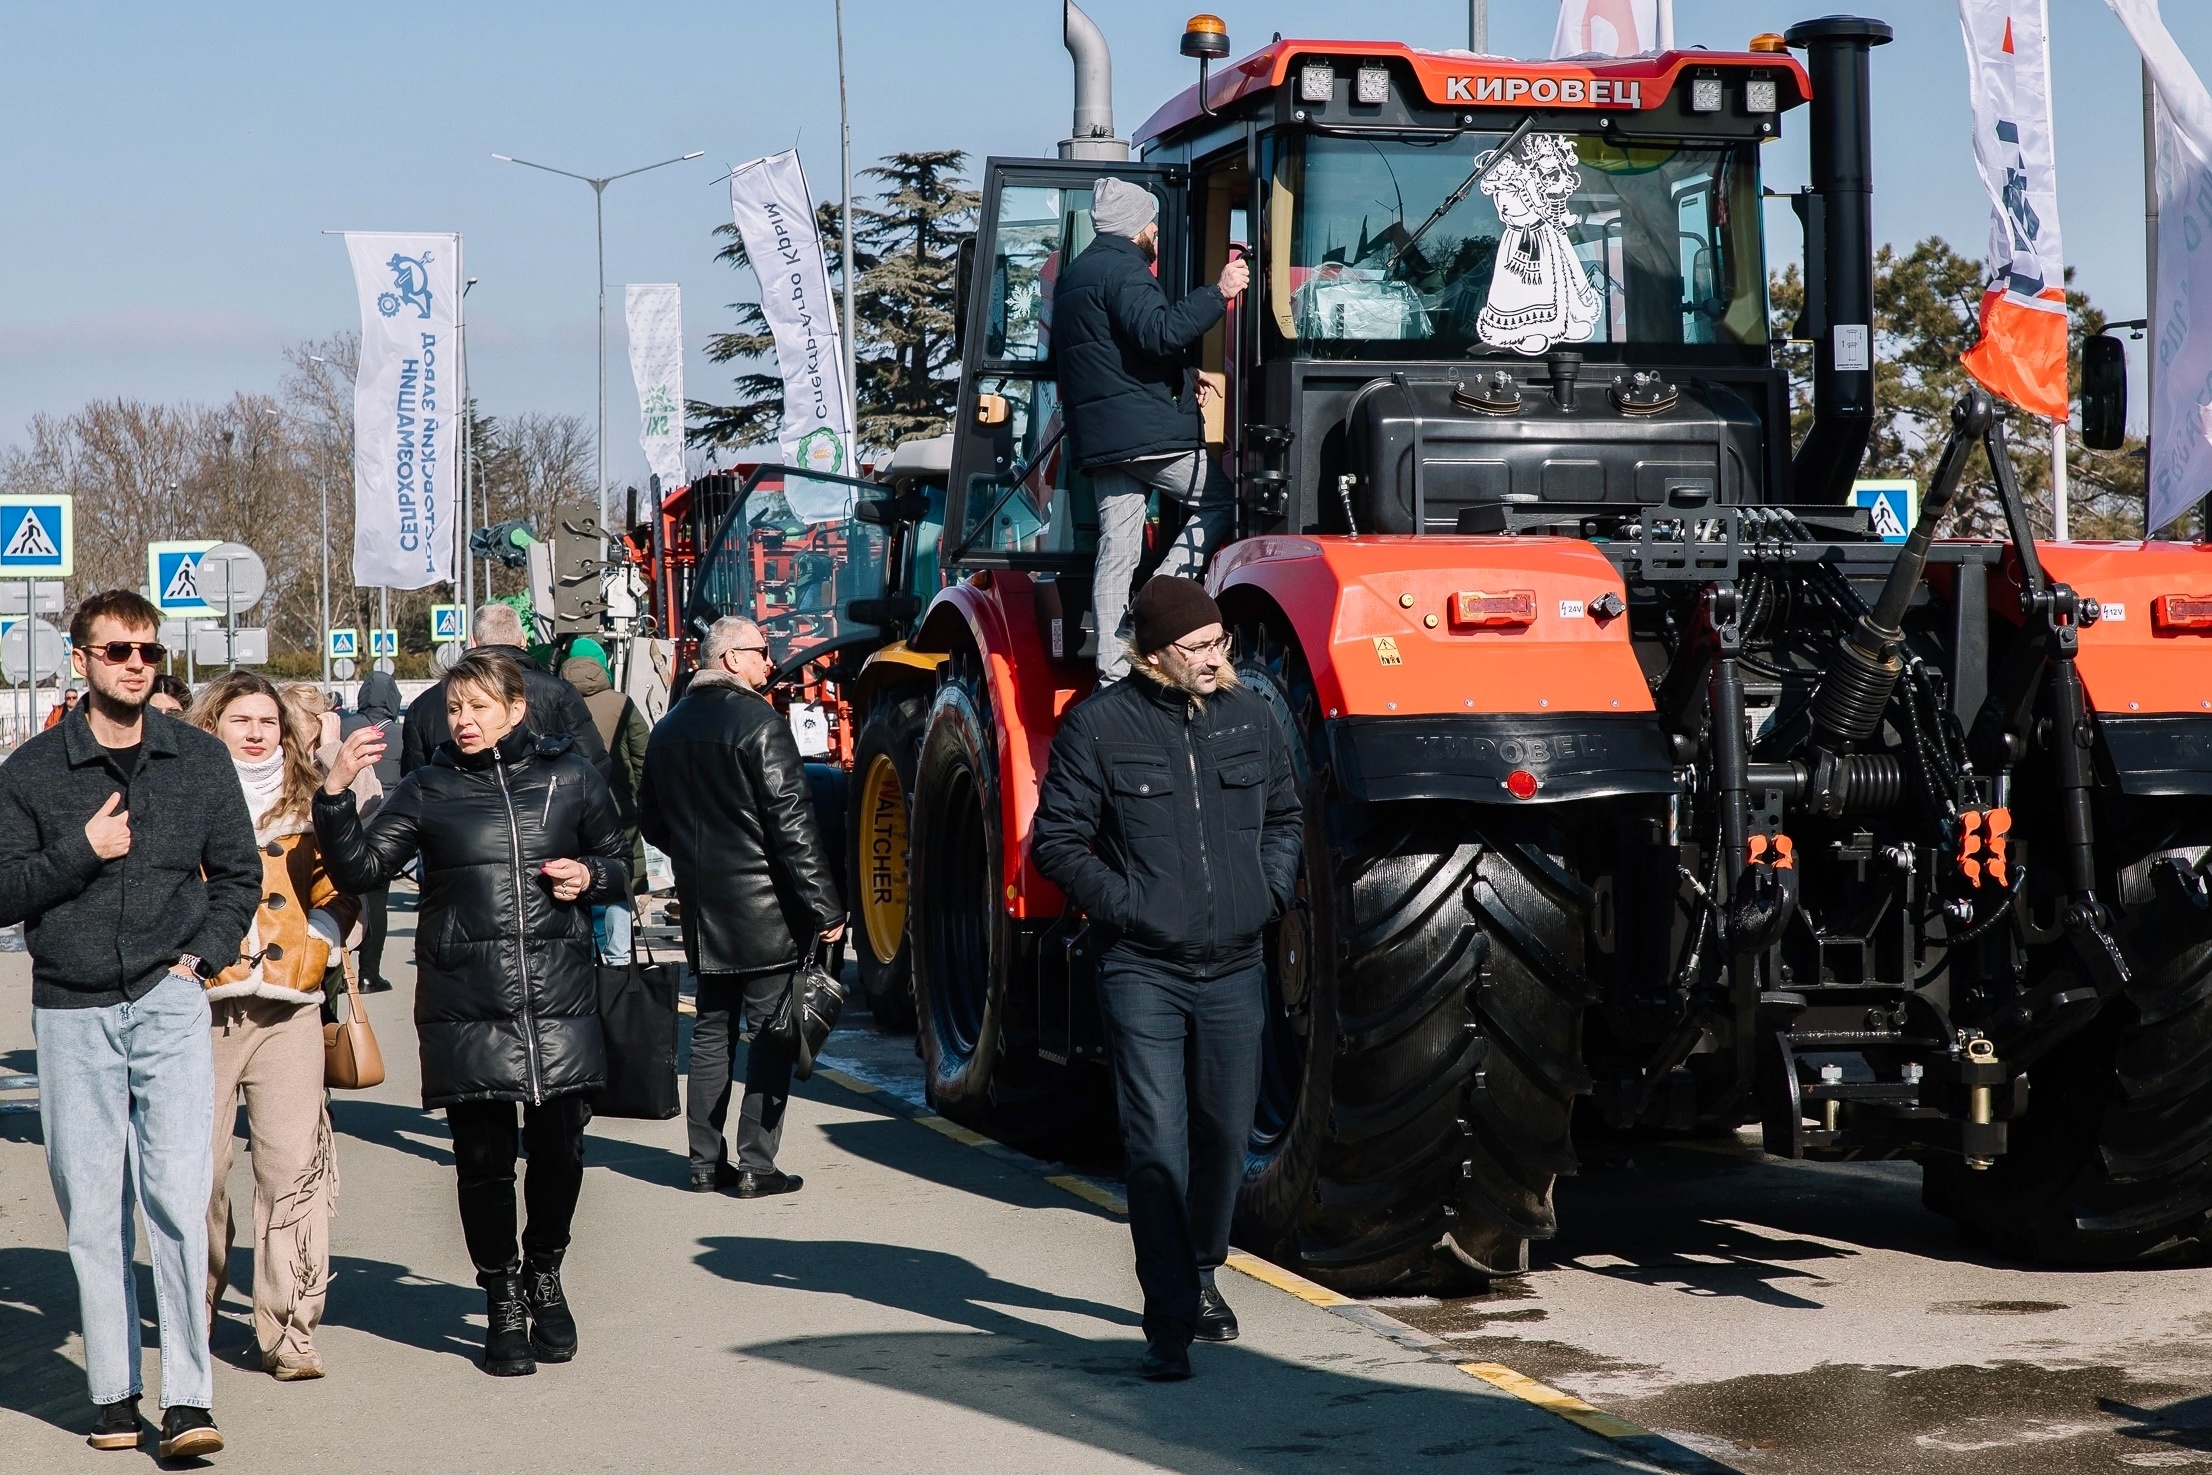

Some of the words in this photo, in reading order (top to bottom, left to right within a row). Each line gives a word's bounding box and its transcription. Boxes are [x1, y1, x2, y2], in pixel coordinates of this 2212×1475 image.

[1446, 76, 1641, 109] КИРОВЕЦ
[1568, 605, 1582, 613] 24V
[2110, 608, 2123, 616] 12V
[1415, 734, 1609, 764] КИРОВЕЦ
[873, 780, 902, 906] WALTCHER
